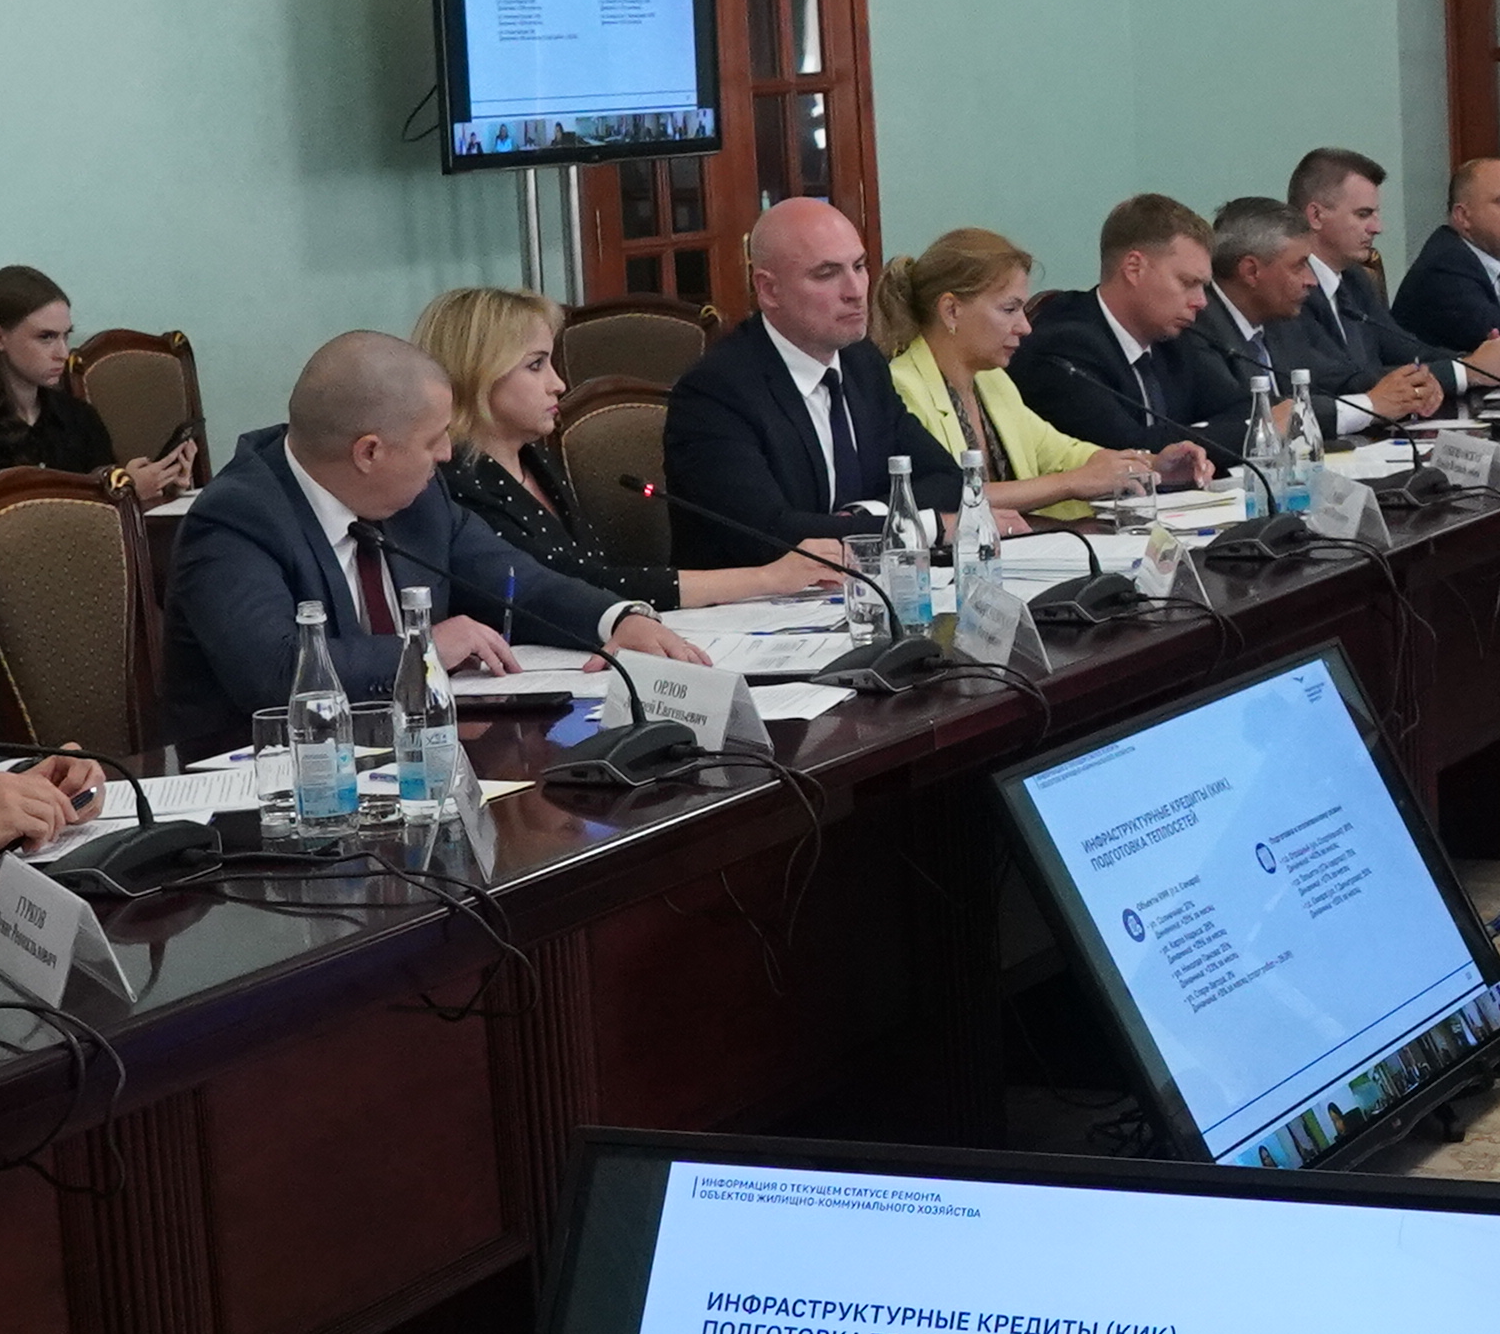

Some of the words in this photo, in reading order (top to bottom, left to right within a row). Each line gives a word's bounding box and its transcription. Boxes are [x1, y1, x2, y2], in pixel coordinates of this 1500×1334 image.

[699, 1189, 755, 1202] ОБЪЕКТОВ
[756, 1194, 915, 1214] ЖИЛИЩНО-КОММУНАЛЬНОГО
[917, 1204, 981, 1218] ХОЗЯЙСТВА
[701, 1178, 778, 1191] ИНФОРМАЦИЯ
[779, 1183, 788, 1192] О
[791, 1183, 842, 1196] ТЕКУЩЕМ
[843, 1187, 888, 1199] СТАТУСЕ
[891, 1190, 941, 1202] РЕМОНТА
[706, 1291, 971, 1331] ИНФРАСТРУКТУРНЫЕ
